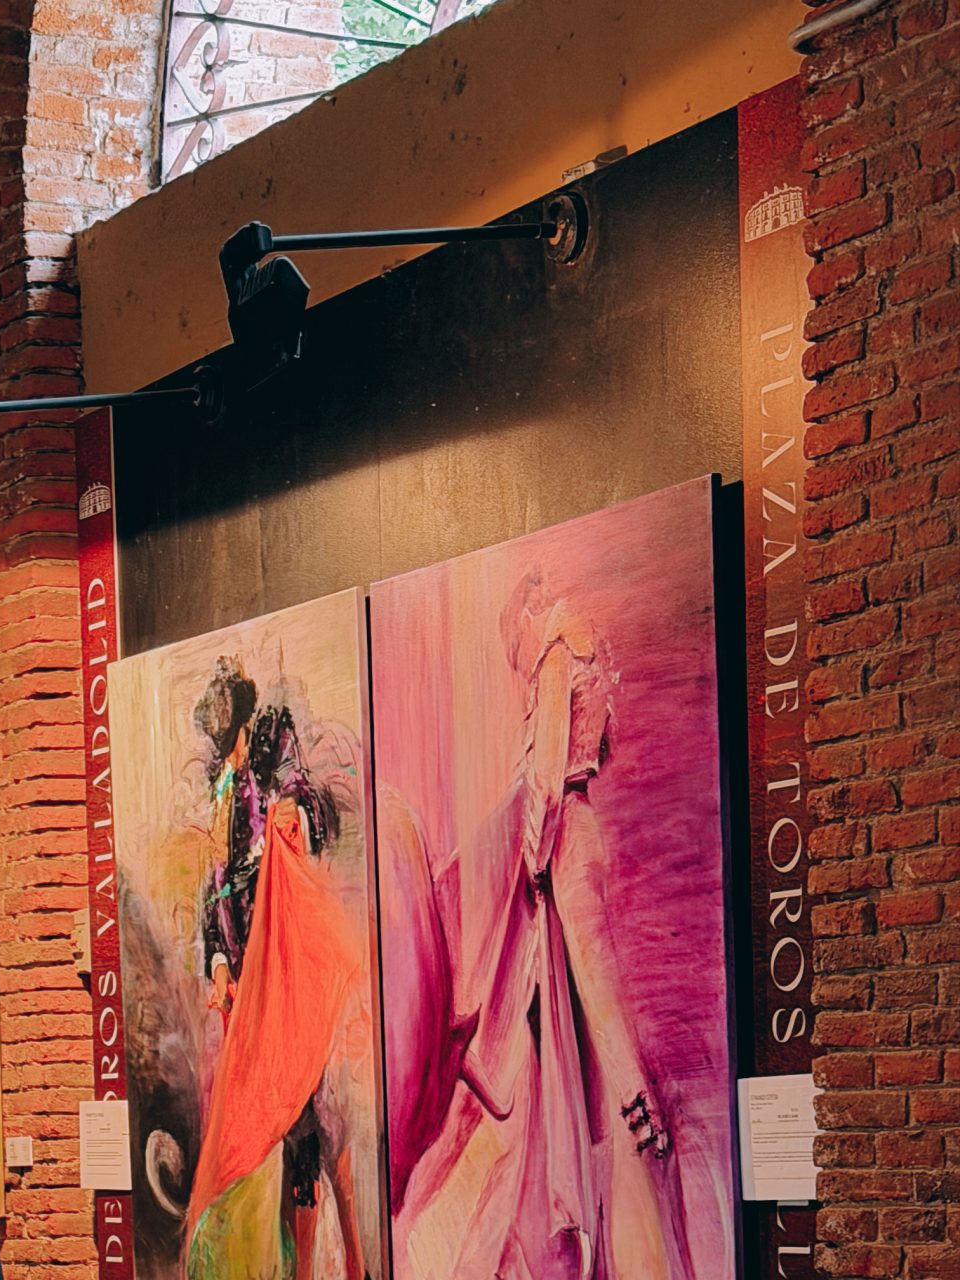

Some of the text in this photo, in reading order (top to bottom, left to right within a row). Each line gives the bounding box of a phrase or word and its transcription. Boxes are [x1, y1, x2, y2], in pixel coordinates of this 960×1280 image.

[760, 321, 797, 578] PLAZA
[87, 577, 116, 938] VALLADOLID
[764, 618, 799, 719] DE
[767, 762, 806, 1044] TOROS
[98, 969, 119, 1101] ROS
[104, 1200, 124, 1264] DE
